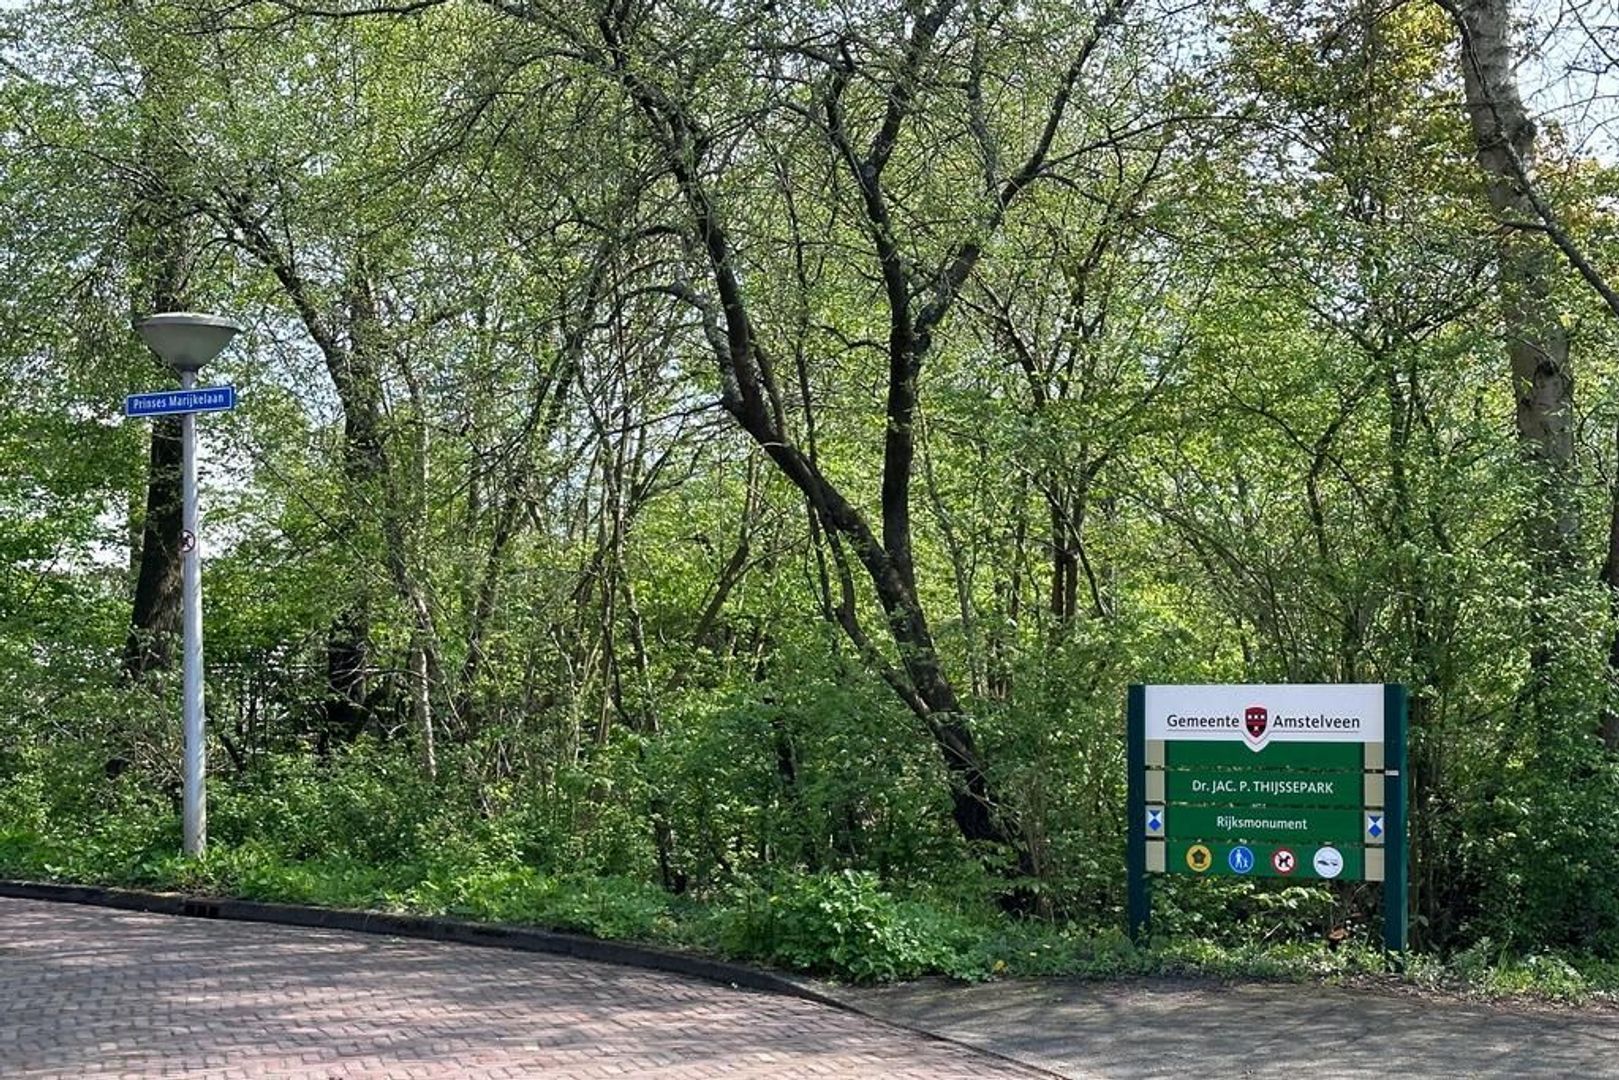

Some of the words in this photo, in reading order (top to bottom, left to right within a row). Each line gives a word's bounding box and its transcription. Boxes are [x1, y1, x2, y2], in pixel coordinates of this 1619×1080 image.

[133, 398, 166, 409] Prinses
[169, 393, 224, 408] Marijkelaan
[1167, 714, 1240, 728] Gemeente
[1273, 714, 1360, 729] Amstelveen
[1192, 779, 1210, 792] Dr.
[1211, 780, 1236, 794] JAC.
[1239, 780, 1251, 792] P.
[1253, 781, 1334, 795] THIJSSEPARK
[1216, 816, 1308, 831] Rijksmonument
